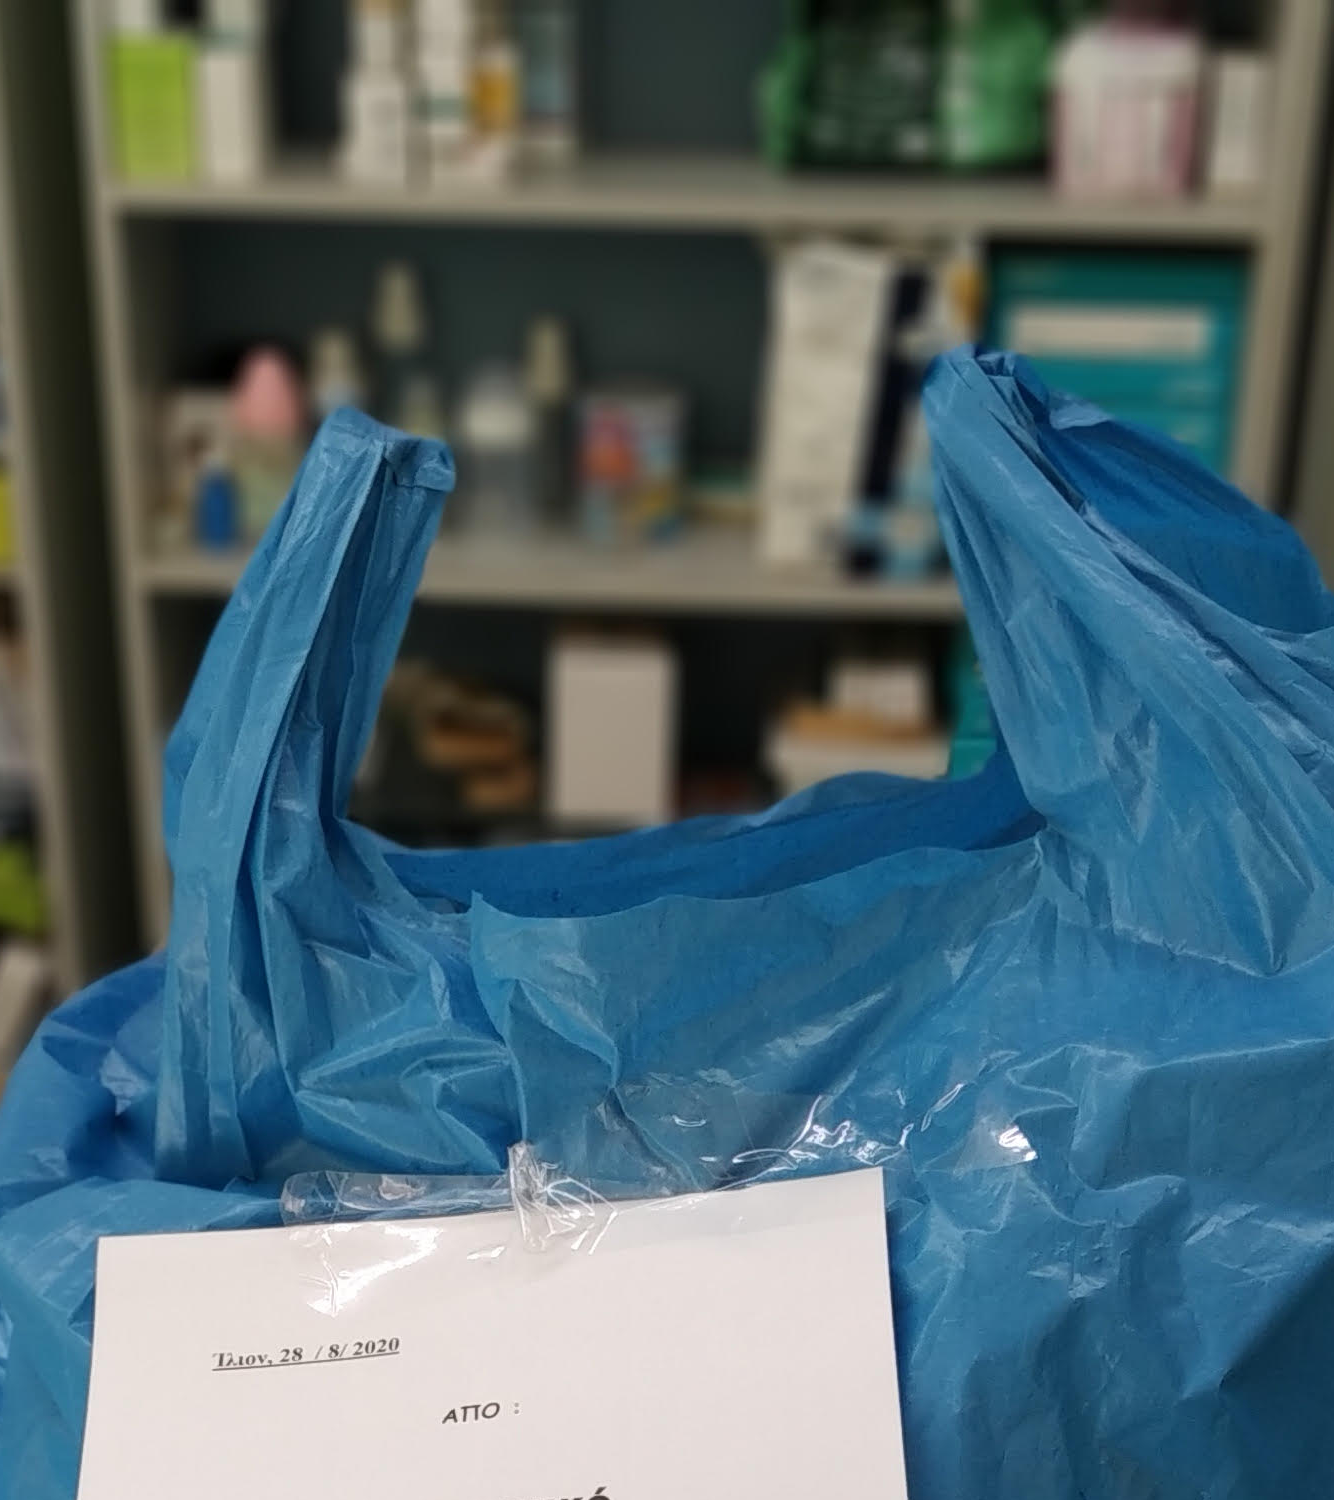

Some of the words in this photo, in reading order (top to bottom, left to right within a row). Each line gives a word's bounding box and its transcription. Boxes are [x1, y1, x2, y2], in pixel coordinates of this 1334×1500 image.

[279, 1346, 304, 1365] 28
[352, 1336, 401, 1359] 2020
[441, 1401, 501, 1425] ΑΠΟ
